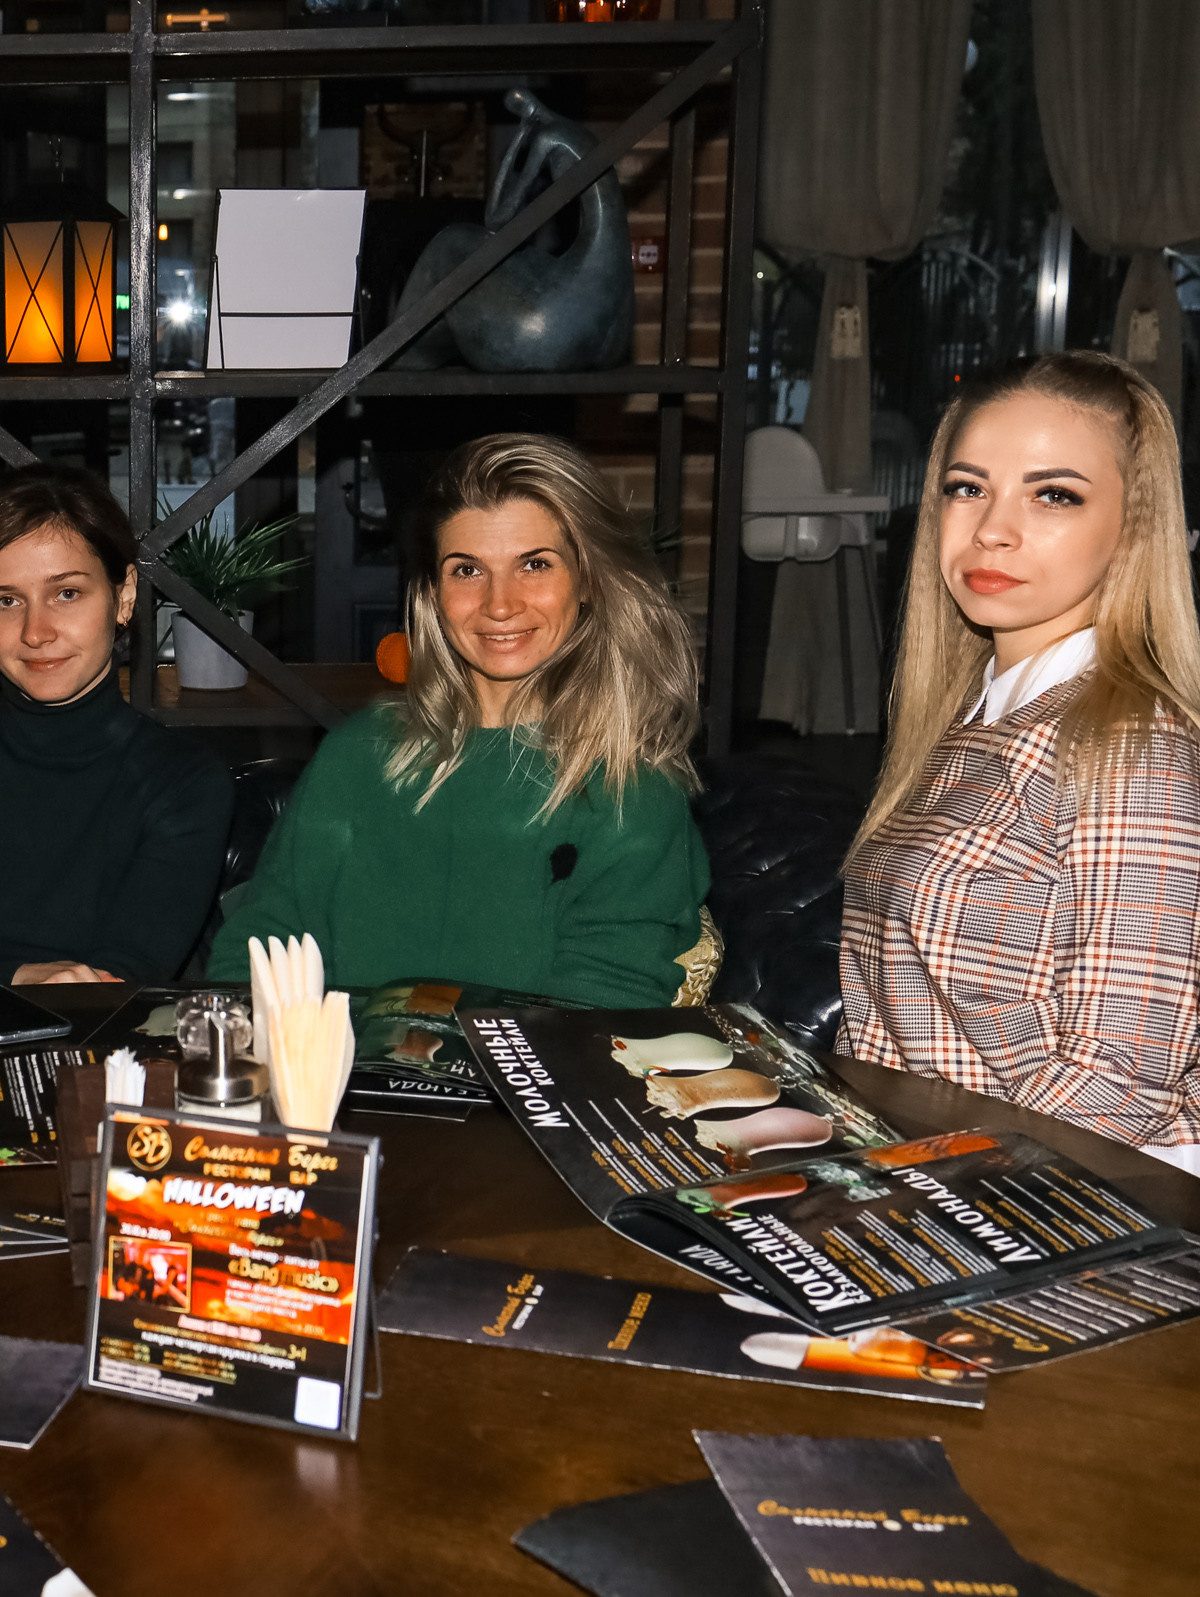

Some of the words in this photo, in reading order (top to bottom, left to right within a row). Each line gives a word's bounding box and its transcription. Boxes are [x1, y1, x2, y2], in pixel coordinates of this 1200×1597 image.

[473, 1018, 570, 1128] МОЛОЧНЫЕ
[500, 1018, 555, 1087] КОКТЕЙЛИ
[203, 1164, 271, 1181] РЕСТОРАН
[289, 1171, 318, 1185] БАР
[288, 1144, 338, 1171] Берег
[163, 1176, 305, 1215] HALLOWEEN
[891, 1168, 1042, 1262] ЛИМОНАДЫ
[725, 1215, 854, 1312] КОКТЕЙЛИ
[756, 1213, 869, 1304] БЕЗАЛКОГОЛЬНЫЕ
[807, 1567, 926, 1593] Пивное
[932, 1578, 1018, 1597] меню
